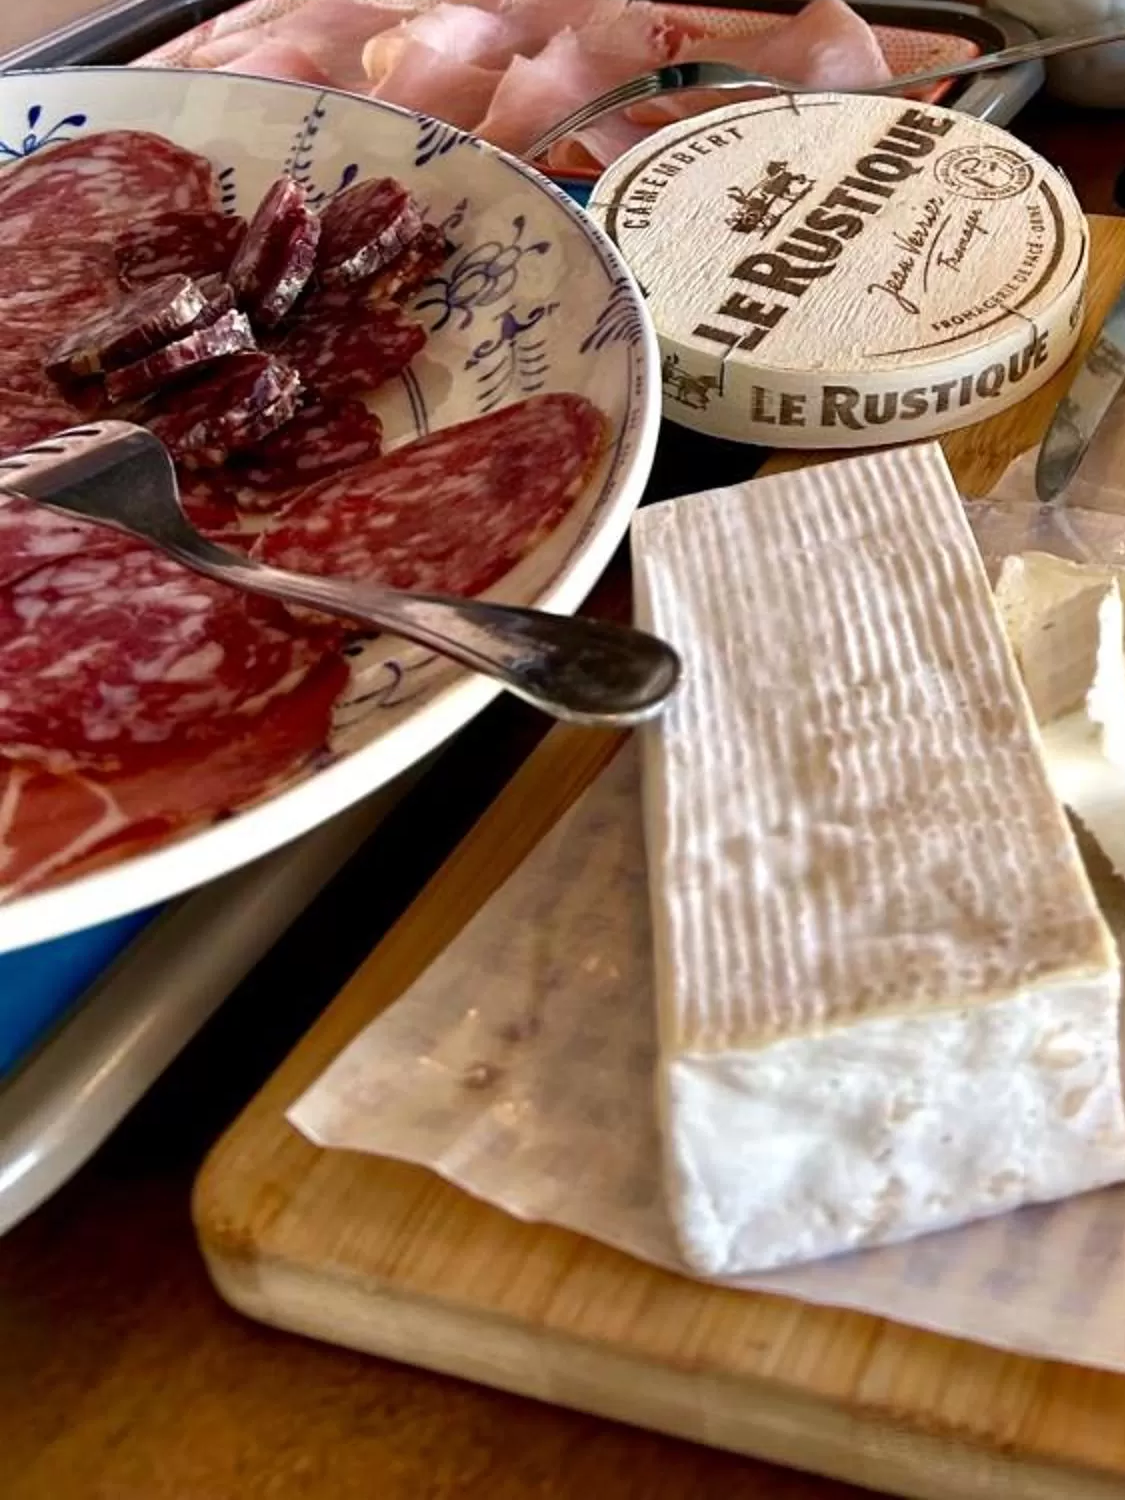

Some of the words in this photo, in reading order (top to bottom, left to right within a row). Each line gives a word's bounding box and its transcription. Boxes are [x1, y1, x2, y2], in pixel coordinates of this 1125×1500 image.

[622, 127, 743, 229] CAMEMBERT
[729, 108, 956, 297] RUSTIQUE
[692, 292, 789, 351] LE
[867, 255, 920, 315] Jean
[932, 283, 1019, 331] FROMAGERIE
[751, 385, 806, 427] LE
[821, 331, 1049, 430] RUSTIQUE
